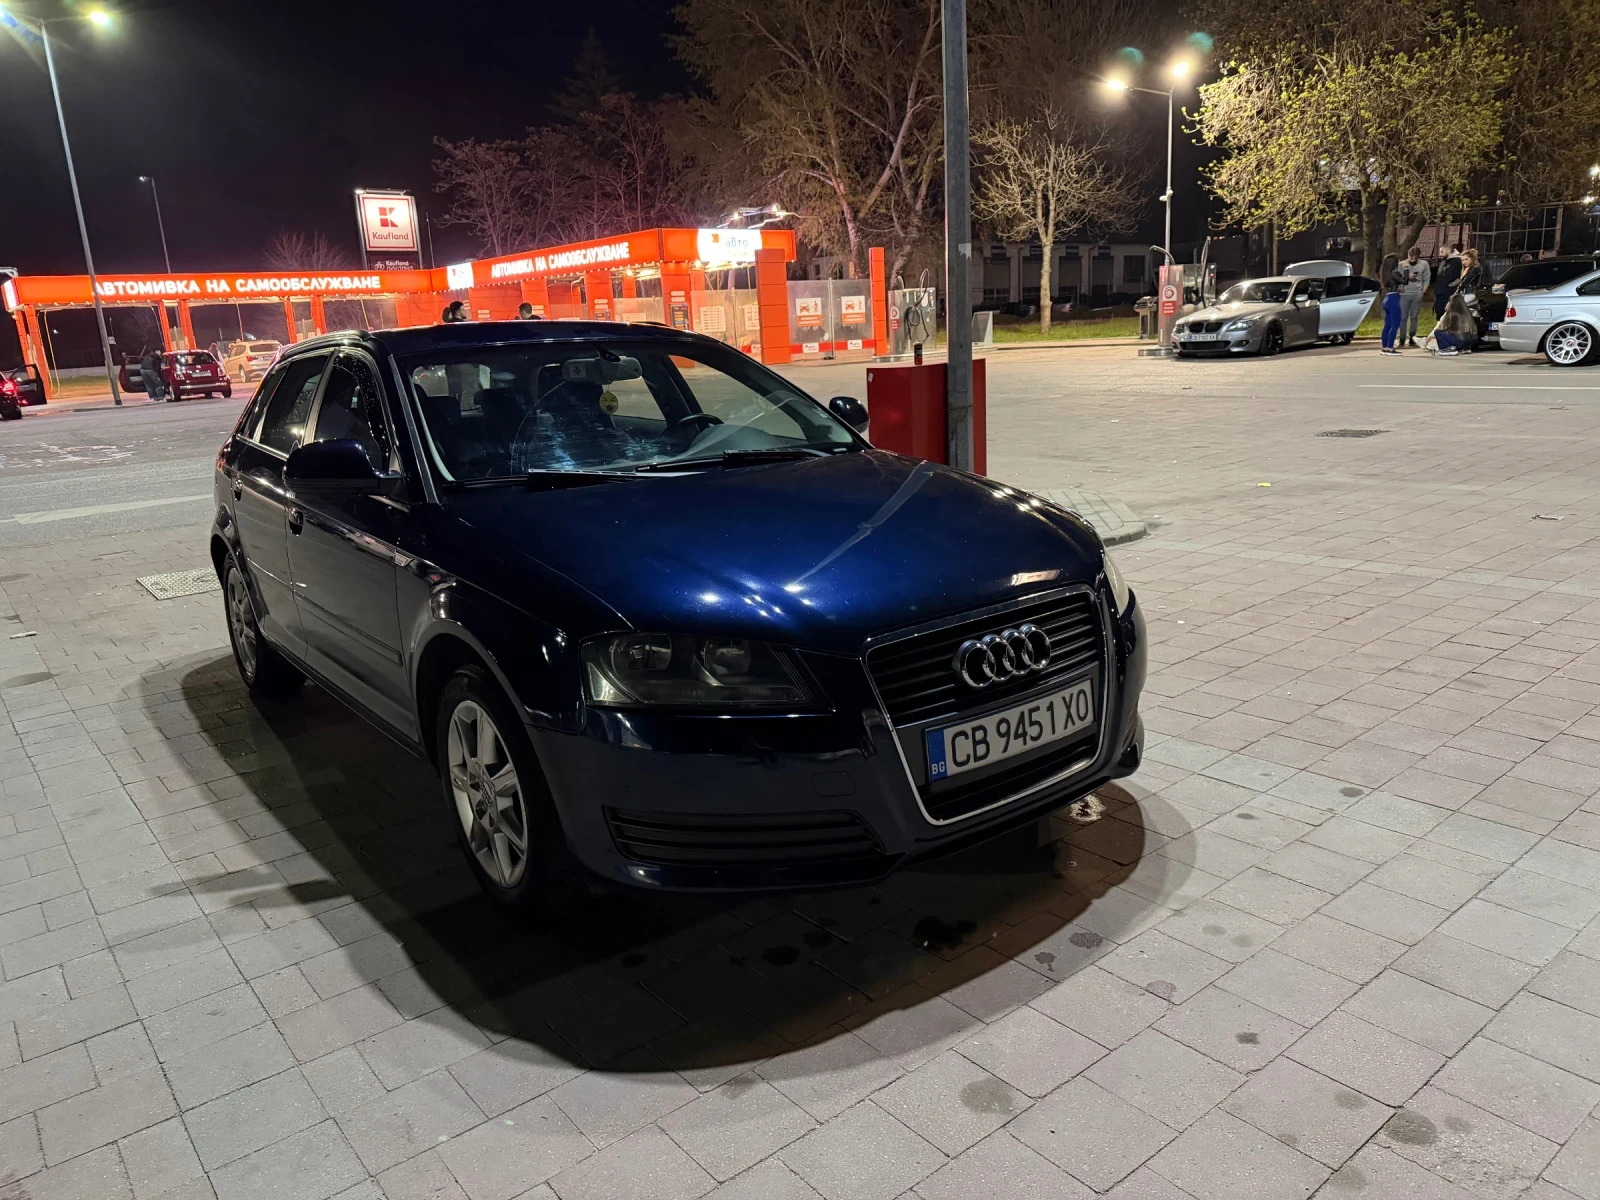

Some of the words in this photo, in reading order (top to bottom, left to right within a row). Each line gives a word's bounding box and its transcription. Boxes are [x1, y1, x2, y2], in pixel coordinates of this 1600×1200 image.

[372, 231, 409, 240] Kaufland
[491, 258, 534, 278] АВТОМИВКА
[535, 255, 547, 271] НА
[548, 242, 630, 270] САМООБСЛУЖВАНЕ
[205, 279, 231, 293] НА
[235, 276, 381, 292] САМООБСЛУЖВАНЕ
[951, 724, 990, 768] CB
[996, 700, 1056, 754] 9451
[1061, 688, 1089, 731] XO
[931, 761, 945, 775] BG
